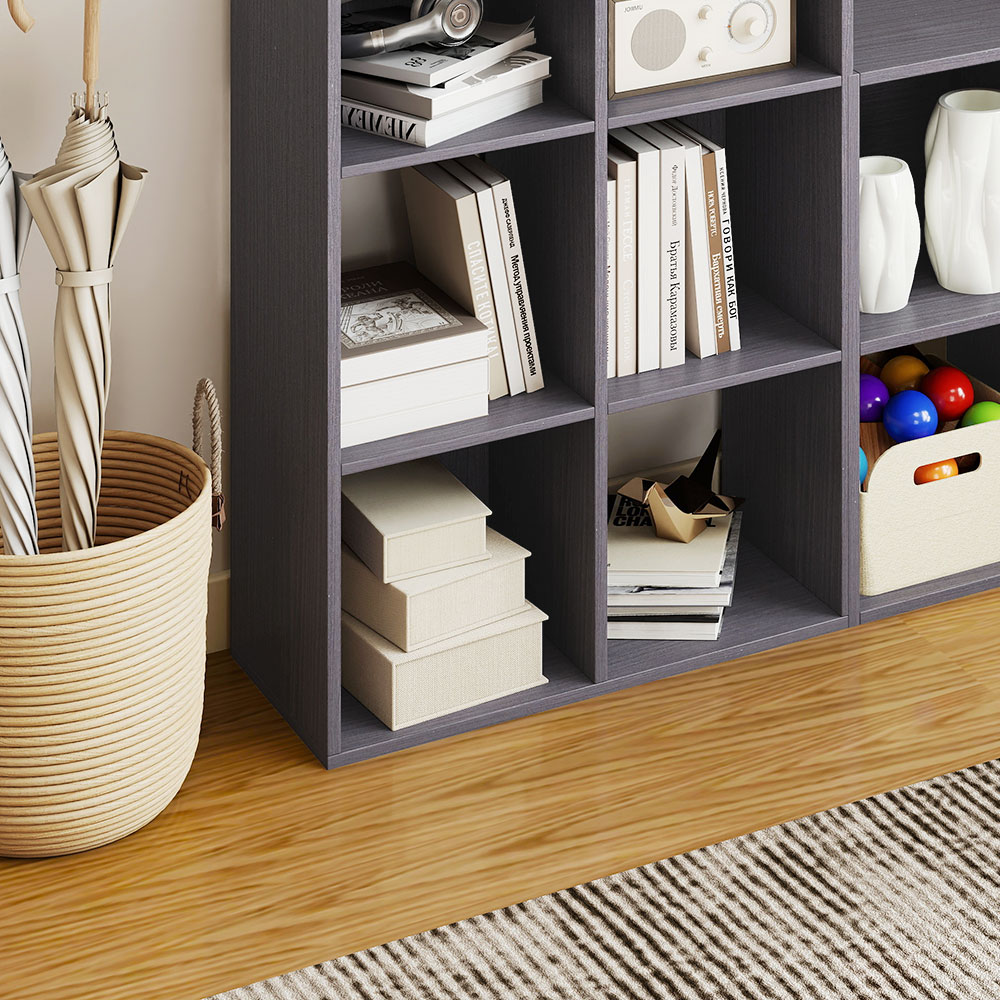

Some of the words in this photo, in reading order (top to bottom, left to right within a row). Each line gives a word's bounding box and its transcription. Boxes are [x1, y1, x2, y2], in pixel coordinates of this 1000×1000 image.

[510, 253, 520, 282] Метод
[667, 240, 680, 280] Братья
[722, 218, 734, 272] ГОВОРИ
[466, 240, 489, 301] СПАСИТЕ
[710, 252, 723, 305] Бархатная
[726, 275, 736, 297] КАК
[512, 278, 530, 333] управления
[666, 282, 681, 351] Карамазовы
[714, 305, 726, 339] смерть
[728, 300, 738, 320] БОГ
[523, 330, 537, 377] проектами
